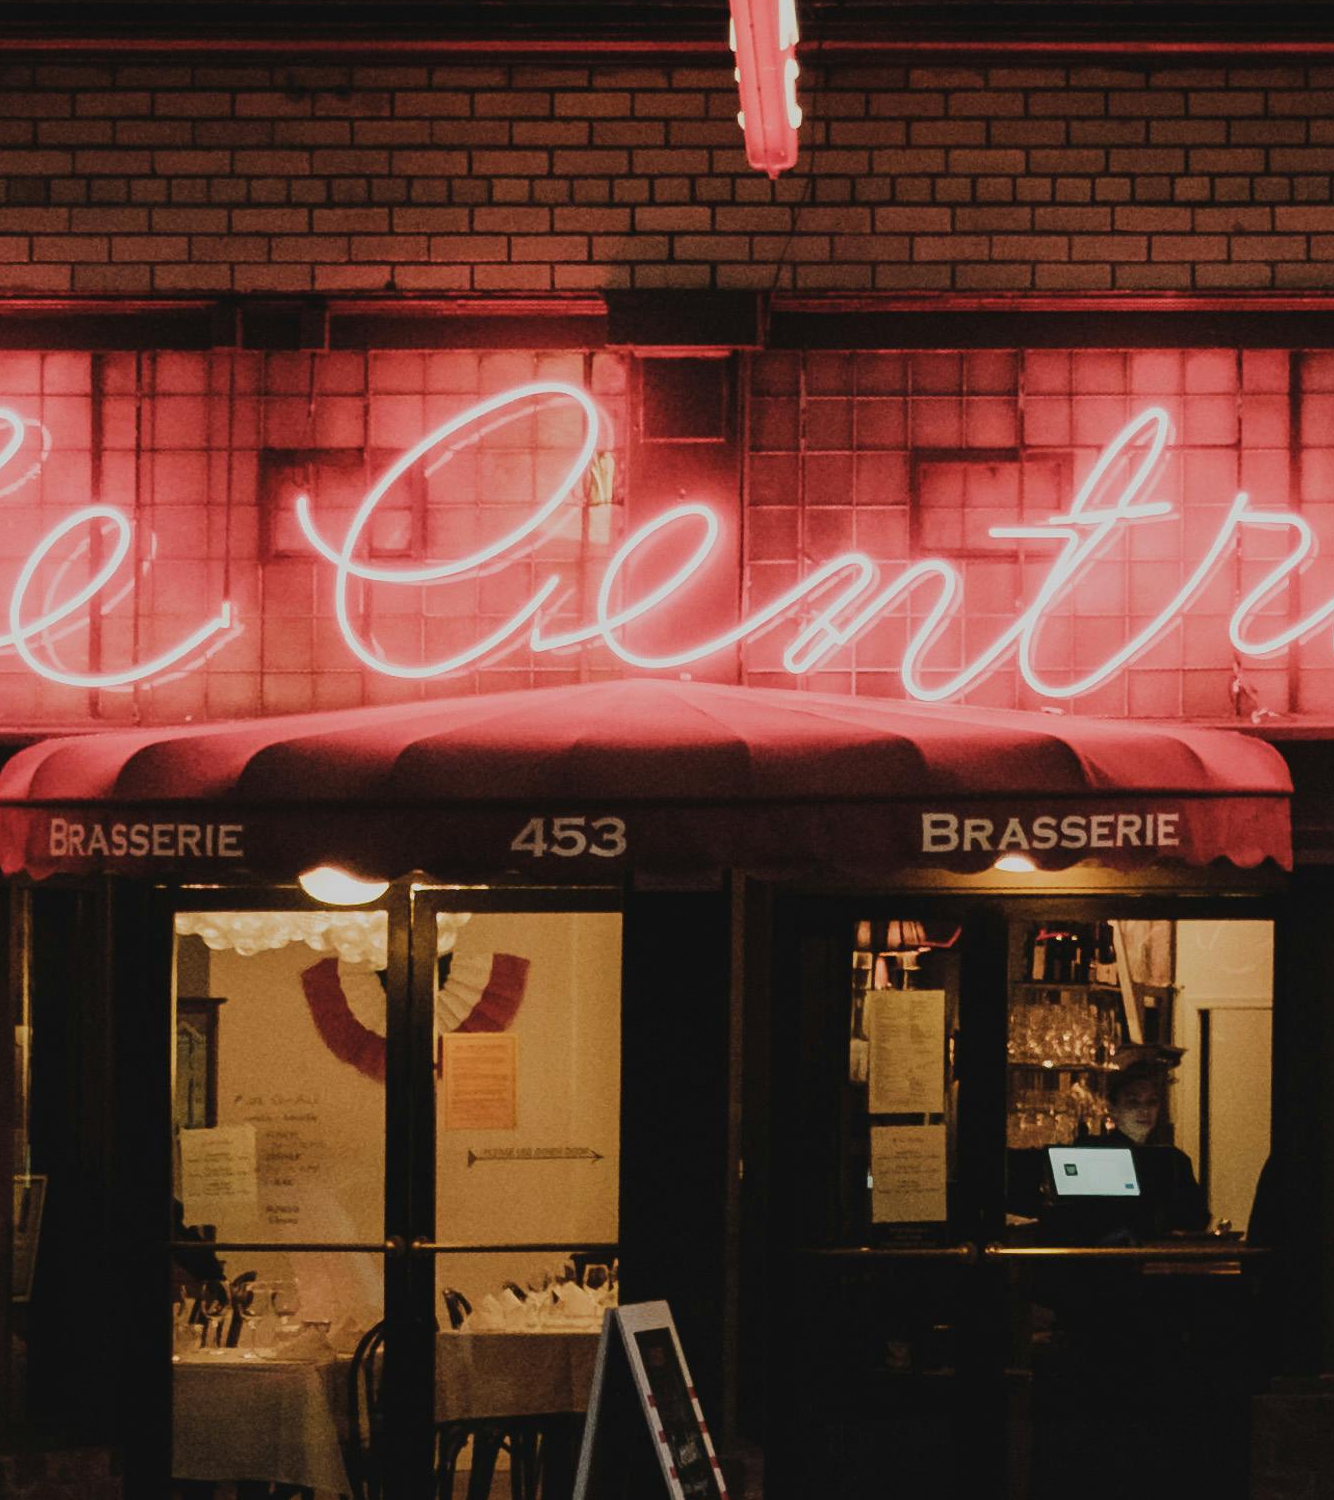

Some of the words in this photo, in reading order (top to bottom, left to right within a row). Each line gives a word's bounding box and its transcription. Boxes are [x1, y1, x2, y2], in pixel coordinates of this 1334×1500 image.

[50, 817, 244, 857] BRASSERIE
[511, 816, 627, 858] 453
[921, 812, 1180, 852] BRASSERIE
